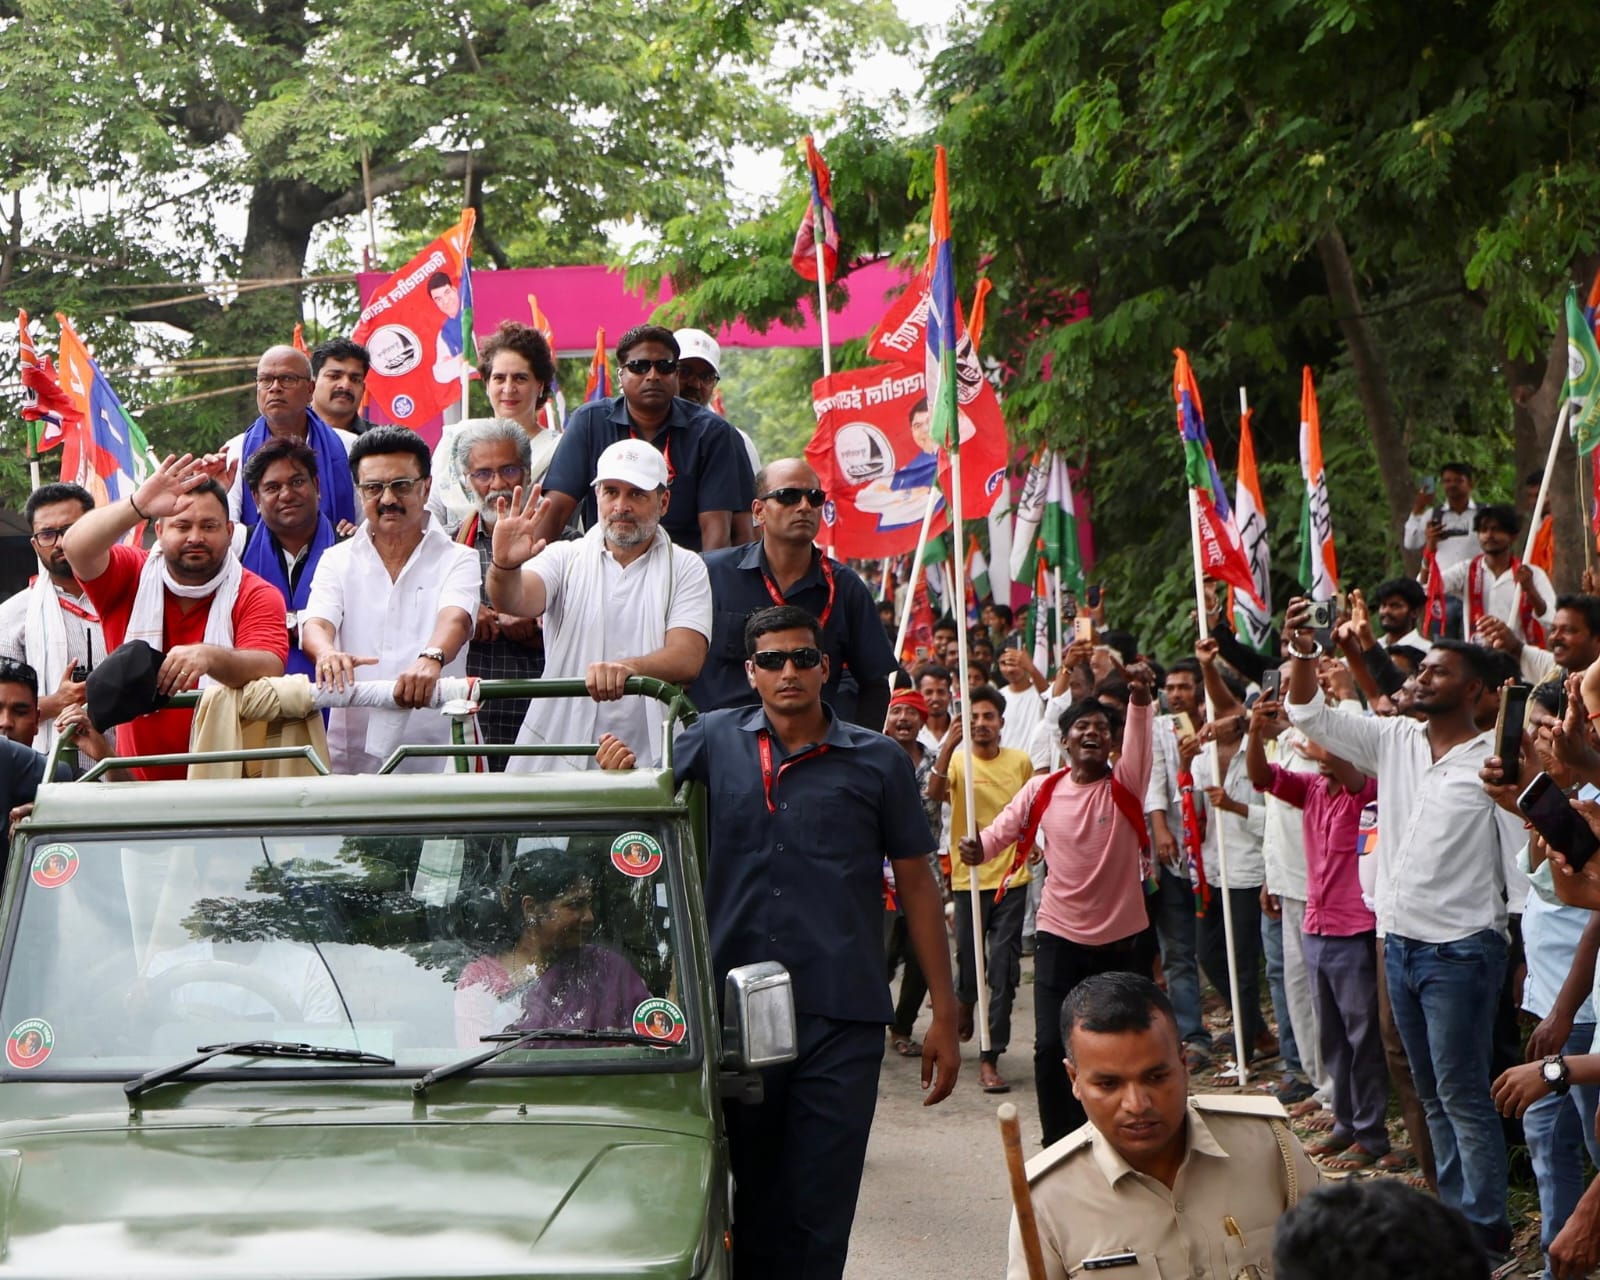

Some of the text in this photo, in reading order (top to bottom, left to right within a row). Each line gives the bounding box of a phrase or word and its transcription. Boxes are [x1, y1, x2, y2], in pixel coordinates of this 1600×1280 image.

[615, 834, 657, 851] CONSERVE TIGER
[637, 1001, 681, 1020] CONSERVE TIGER
